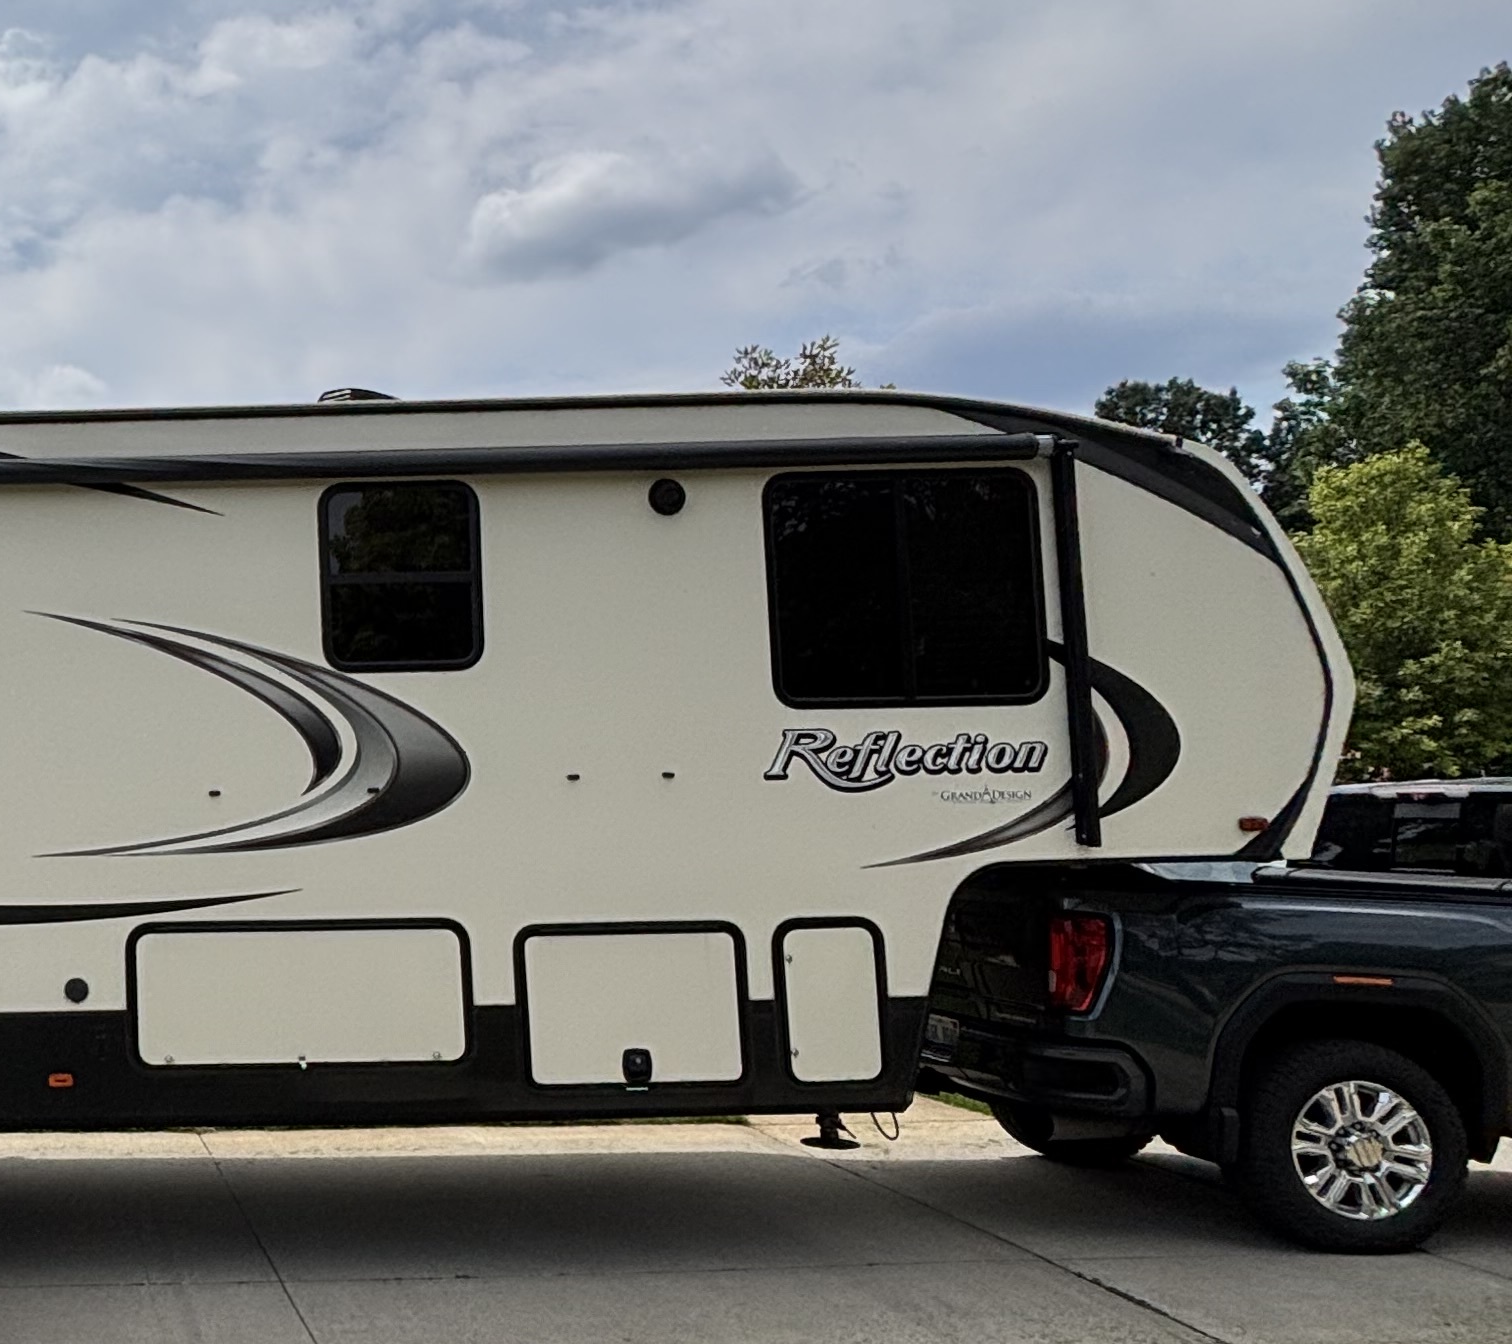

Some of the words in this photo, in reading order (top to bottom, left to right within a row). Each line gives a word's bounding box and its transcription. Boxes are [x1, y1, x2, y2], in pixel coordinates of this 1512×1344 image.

[764, 728, 1048, 793] Reflection
[940, 790, 981, 801] GRAND
[992, 789, 1032, 800] DESIGN
